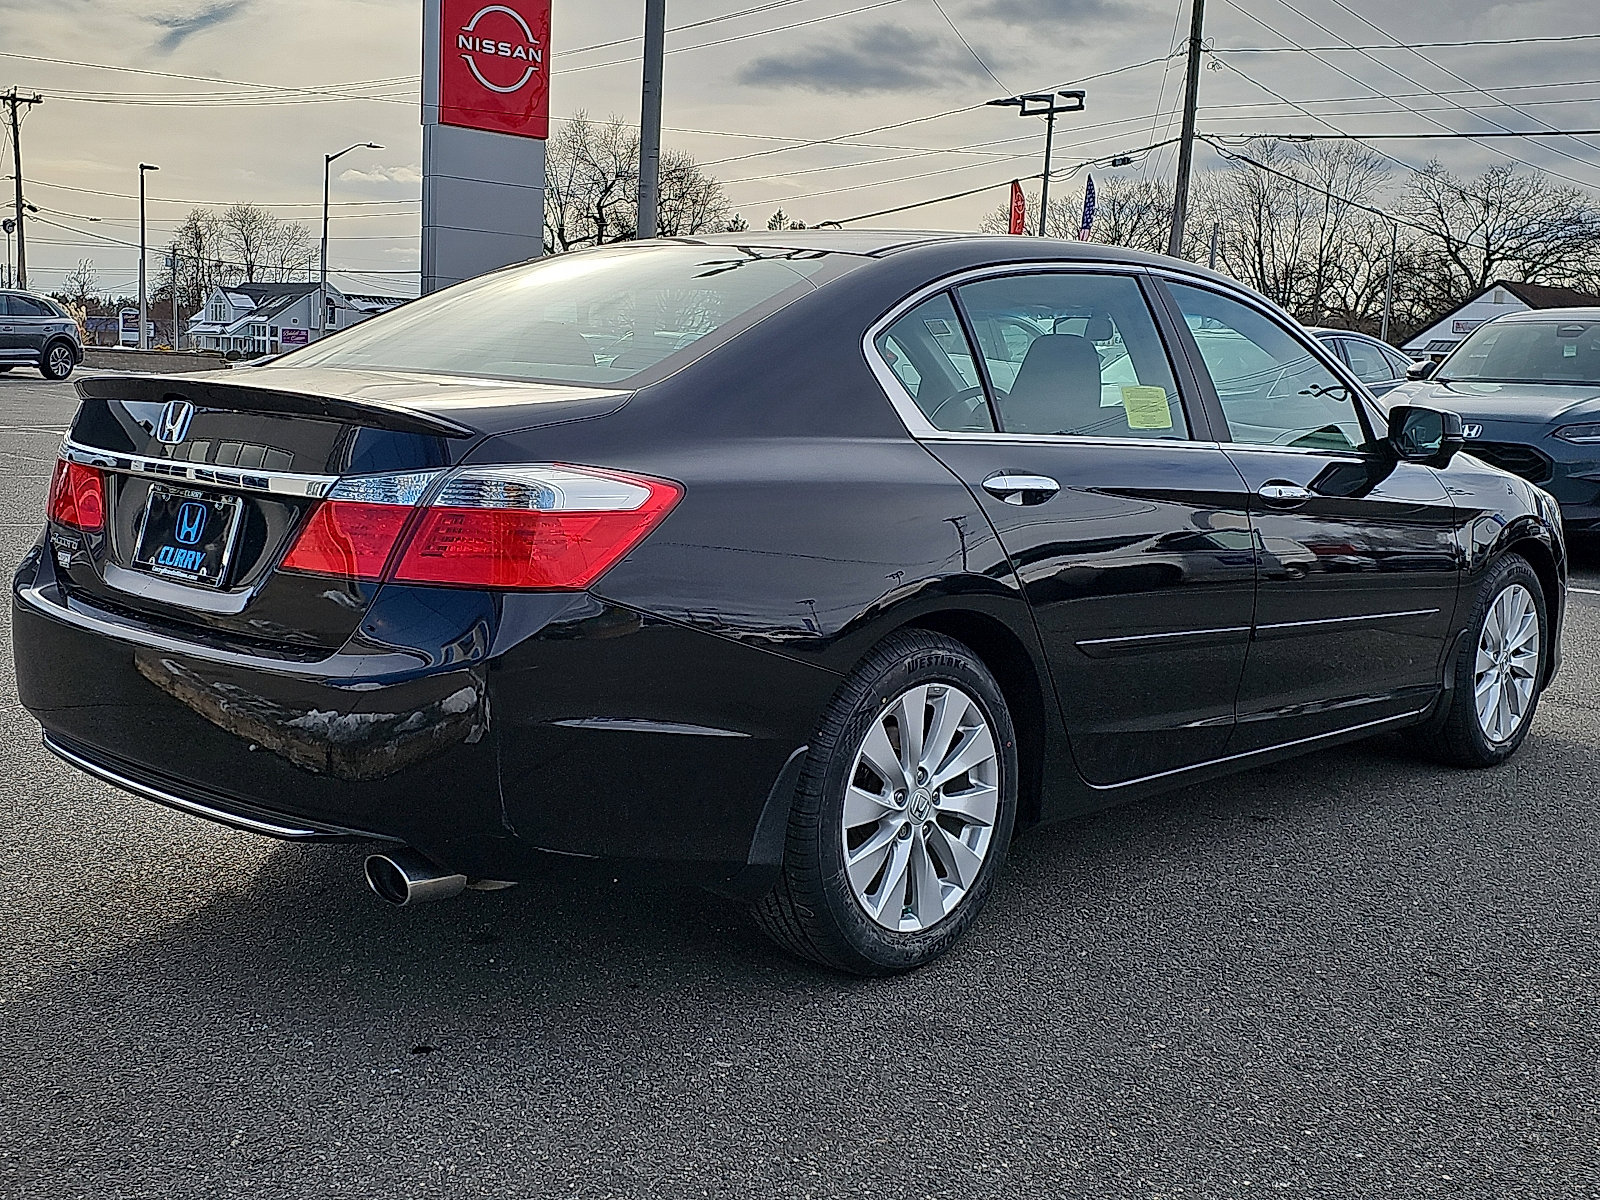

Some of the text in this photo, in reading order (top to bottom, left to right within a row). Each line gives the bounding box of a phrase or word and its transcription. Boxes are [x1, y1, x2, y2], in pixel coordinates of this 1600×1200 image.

[458, 34, 542, 63] NISSAN
[158, 546, 206, 571] CURRY
[904, 654, 969, 675] WESTLAKE
